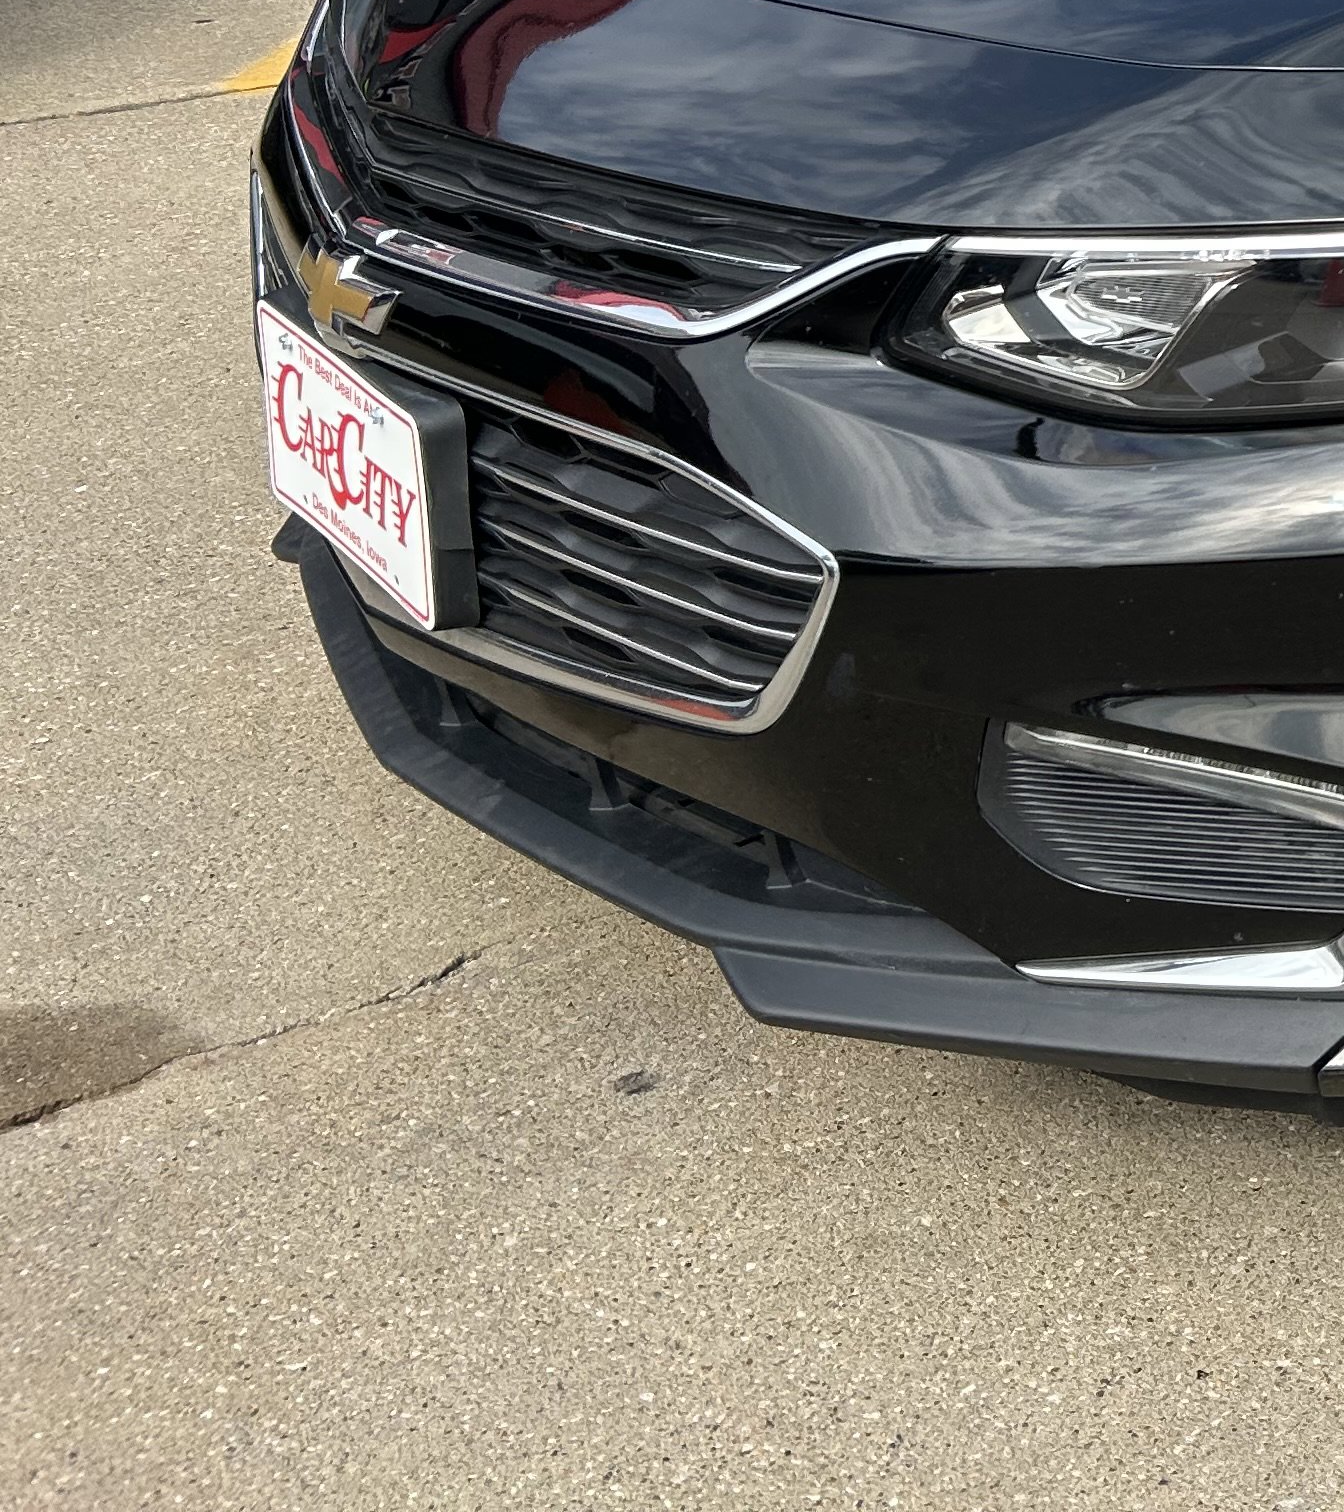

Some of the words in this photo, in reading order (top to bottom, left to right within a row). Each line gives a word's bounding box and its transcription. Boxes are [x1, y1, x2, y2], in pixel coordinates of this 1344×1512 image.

[298, 344, 313, 369] The
[315, 357, 333, 385] Best
[335, 375, 352, 401] Deal
[354, 389, 362, 410] Is
[312, 492, 329, 520] Des
[366, 539, 388, 572] Iowa
